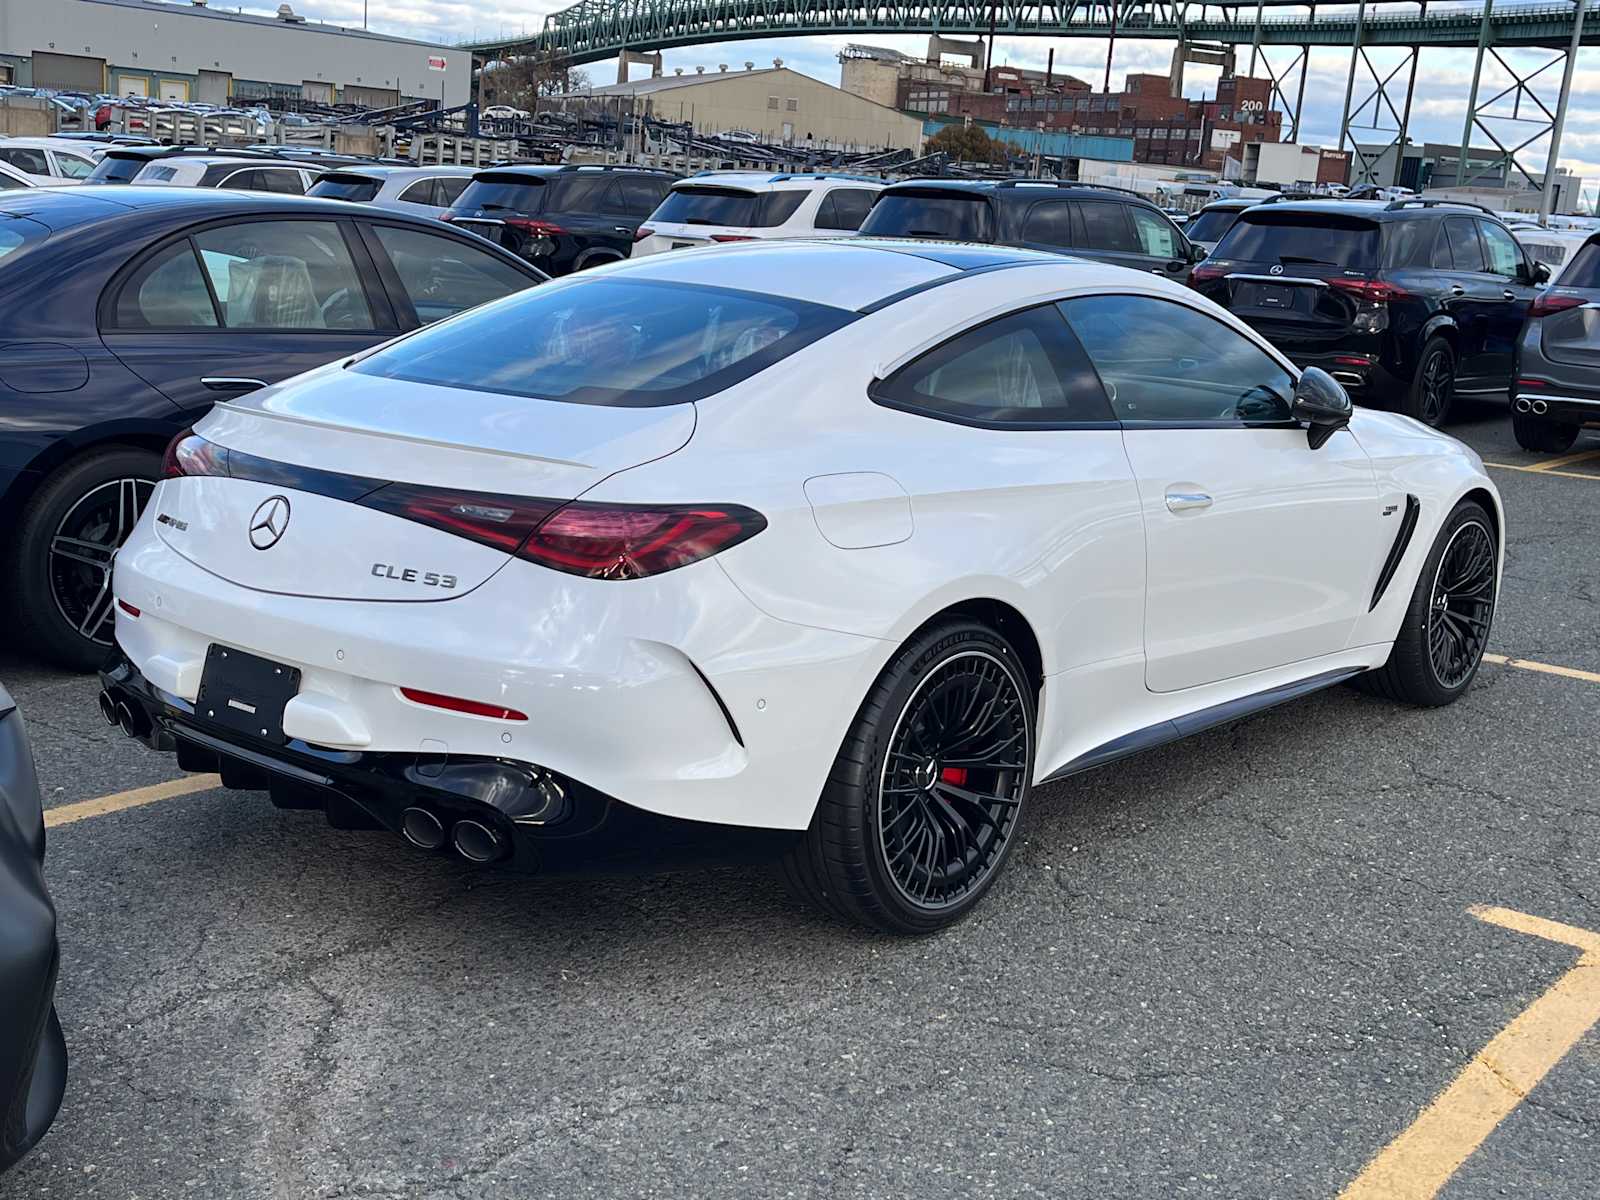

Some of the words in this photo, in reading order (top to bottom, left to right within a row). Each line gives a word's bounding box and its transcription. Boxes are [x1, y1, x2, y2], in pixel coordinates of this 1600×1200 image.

[1240, 100, 1263, 111] 200
[371, 563, 418, 582] CLE
[423, 572, 458, 589] 53
